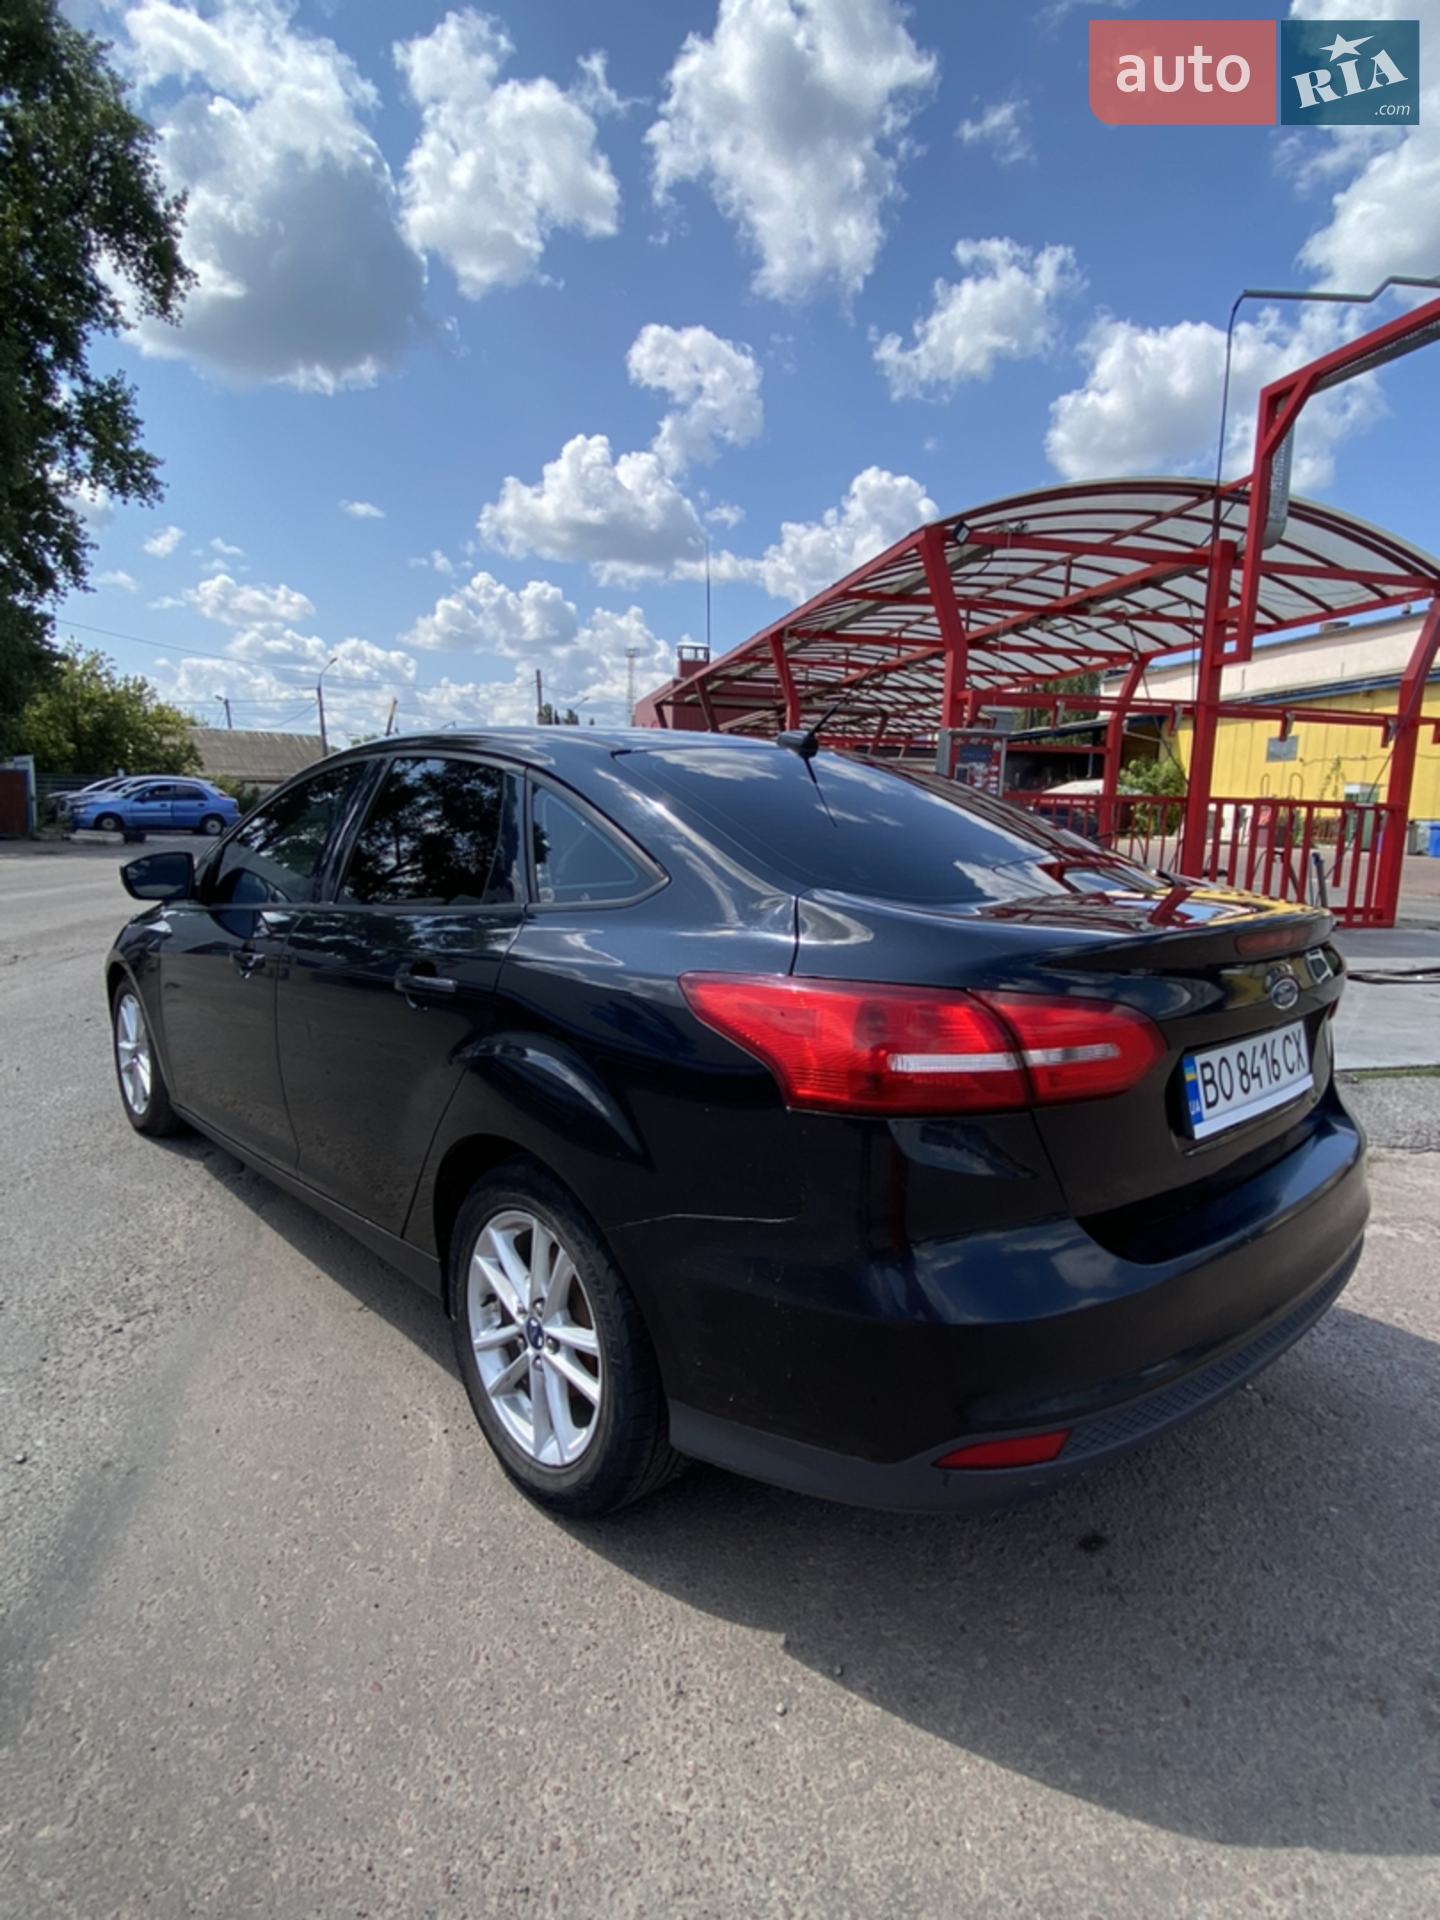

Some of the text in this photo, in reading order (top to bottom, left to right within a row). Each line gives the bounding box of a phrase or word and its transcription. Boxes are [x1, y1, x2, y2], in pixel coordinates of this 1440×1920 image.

[1200, 1029, 1307, 1110] BO 8416 CX
